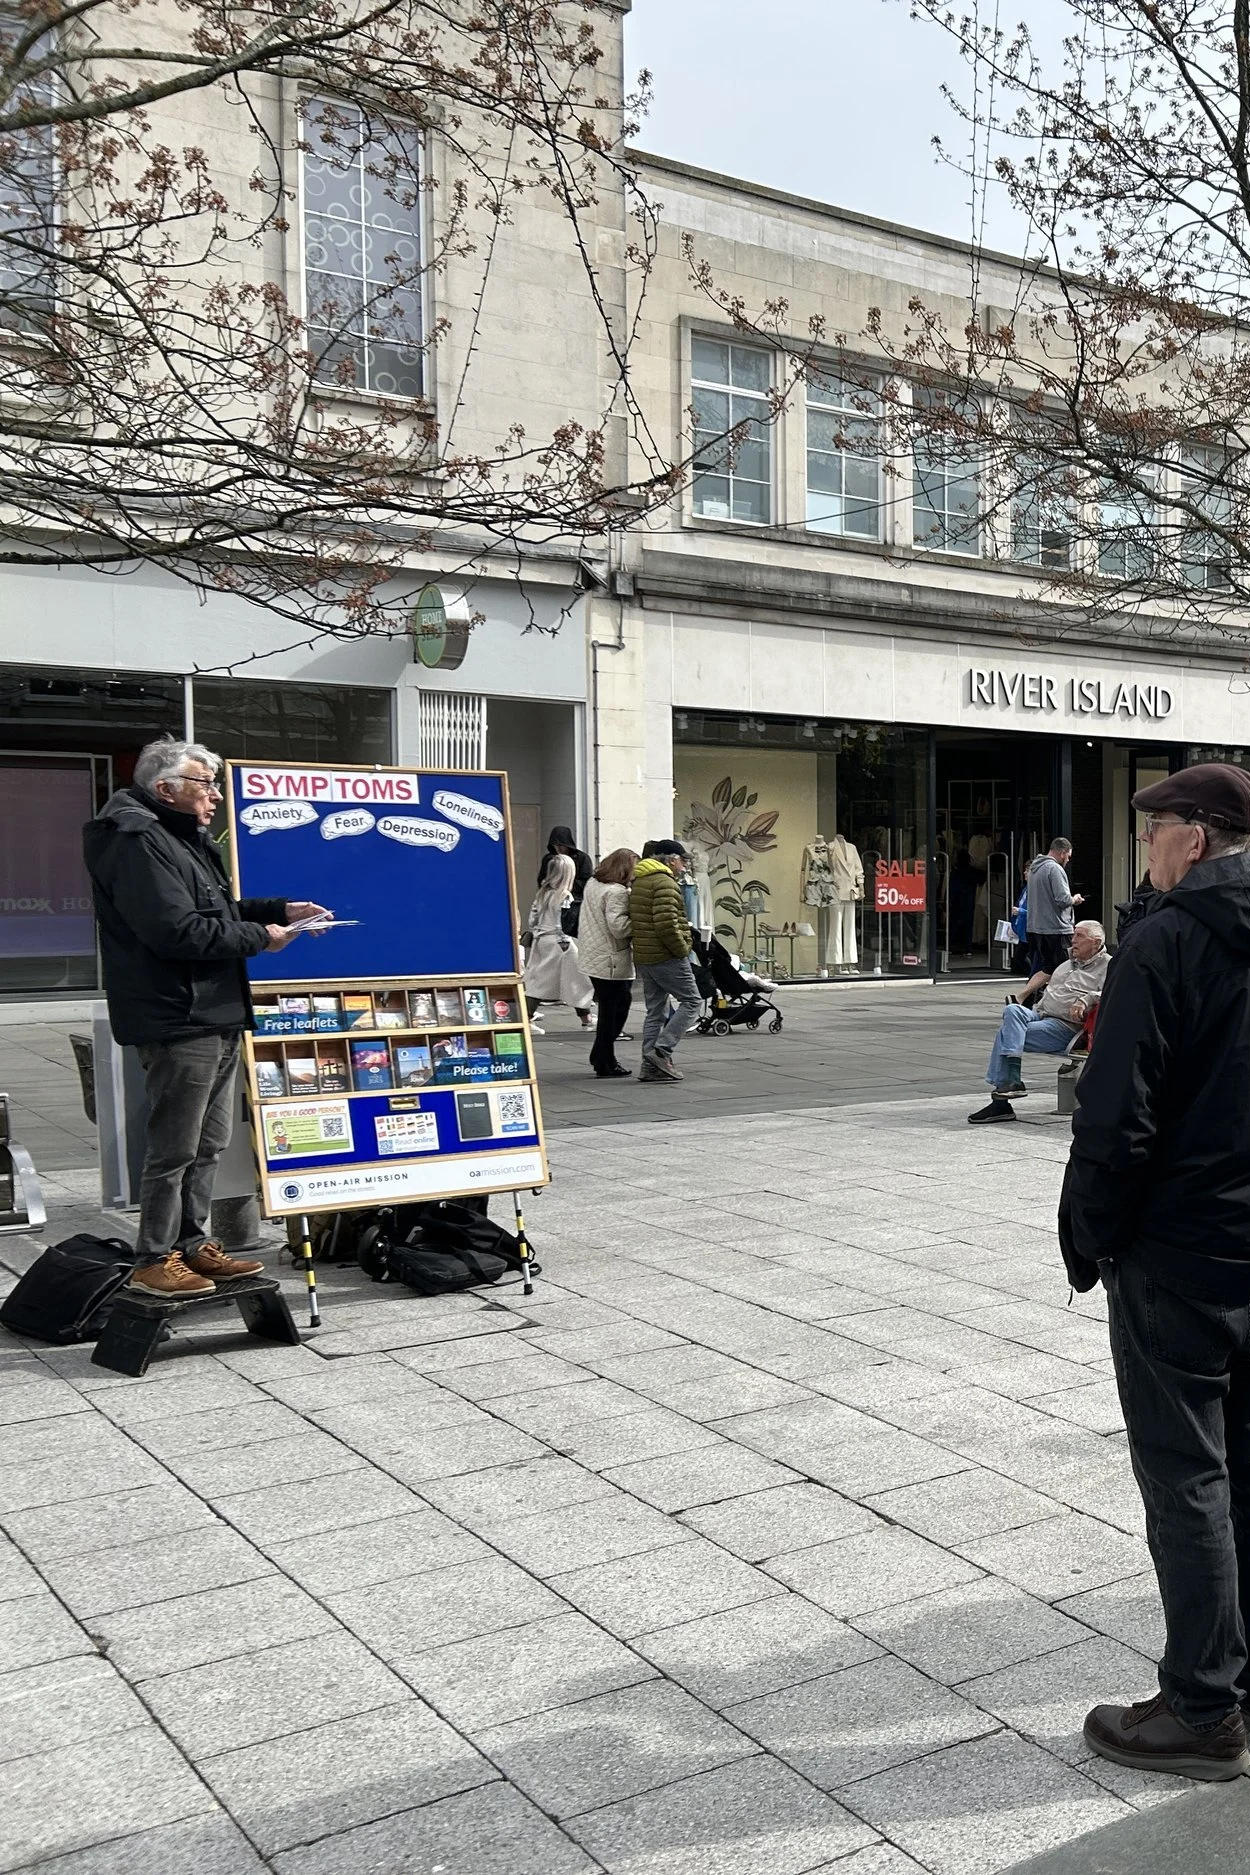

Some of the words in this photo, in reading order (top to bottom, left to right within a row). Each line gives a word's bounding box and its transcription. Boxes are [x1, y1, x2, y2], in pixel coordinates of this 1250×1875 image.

[969, 668, 1058, 710] RIVER
[1071, 678, 1175, 718] ISLAND
[246, 773, 413, 801] SYMPTOMS
[251, 808, 303, 822] Anxiety
[438, 794, 500, 830] Loneliness
[334, 815, 364, 830] Fear
[382, 819, 456, 843] Depression
[875, 859, 927, 877] SALE
[877, 888, 909, 906] 50%
[264, 1019, 292, 1031] Free
[293, 1017, 338, 1030] leaflets
[453, 1065, 488, 1077] Please
[490, 1062, 518, 1076] take!
[469, 1163, 535, 1178] oamission.com
[308, 1177, 361, 1190] OPEN-AIR
[365, 1173, 409, 1184] MISSION
